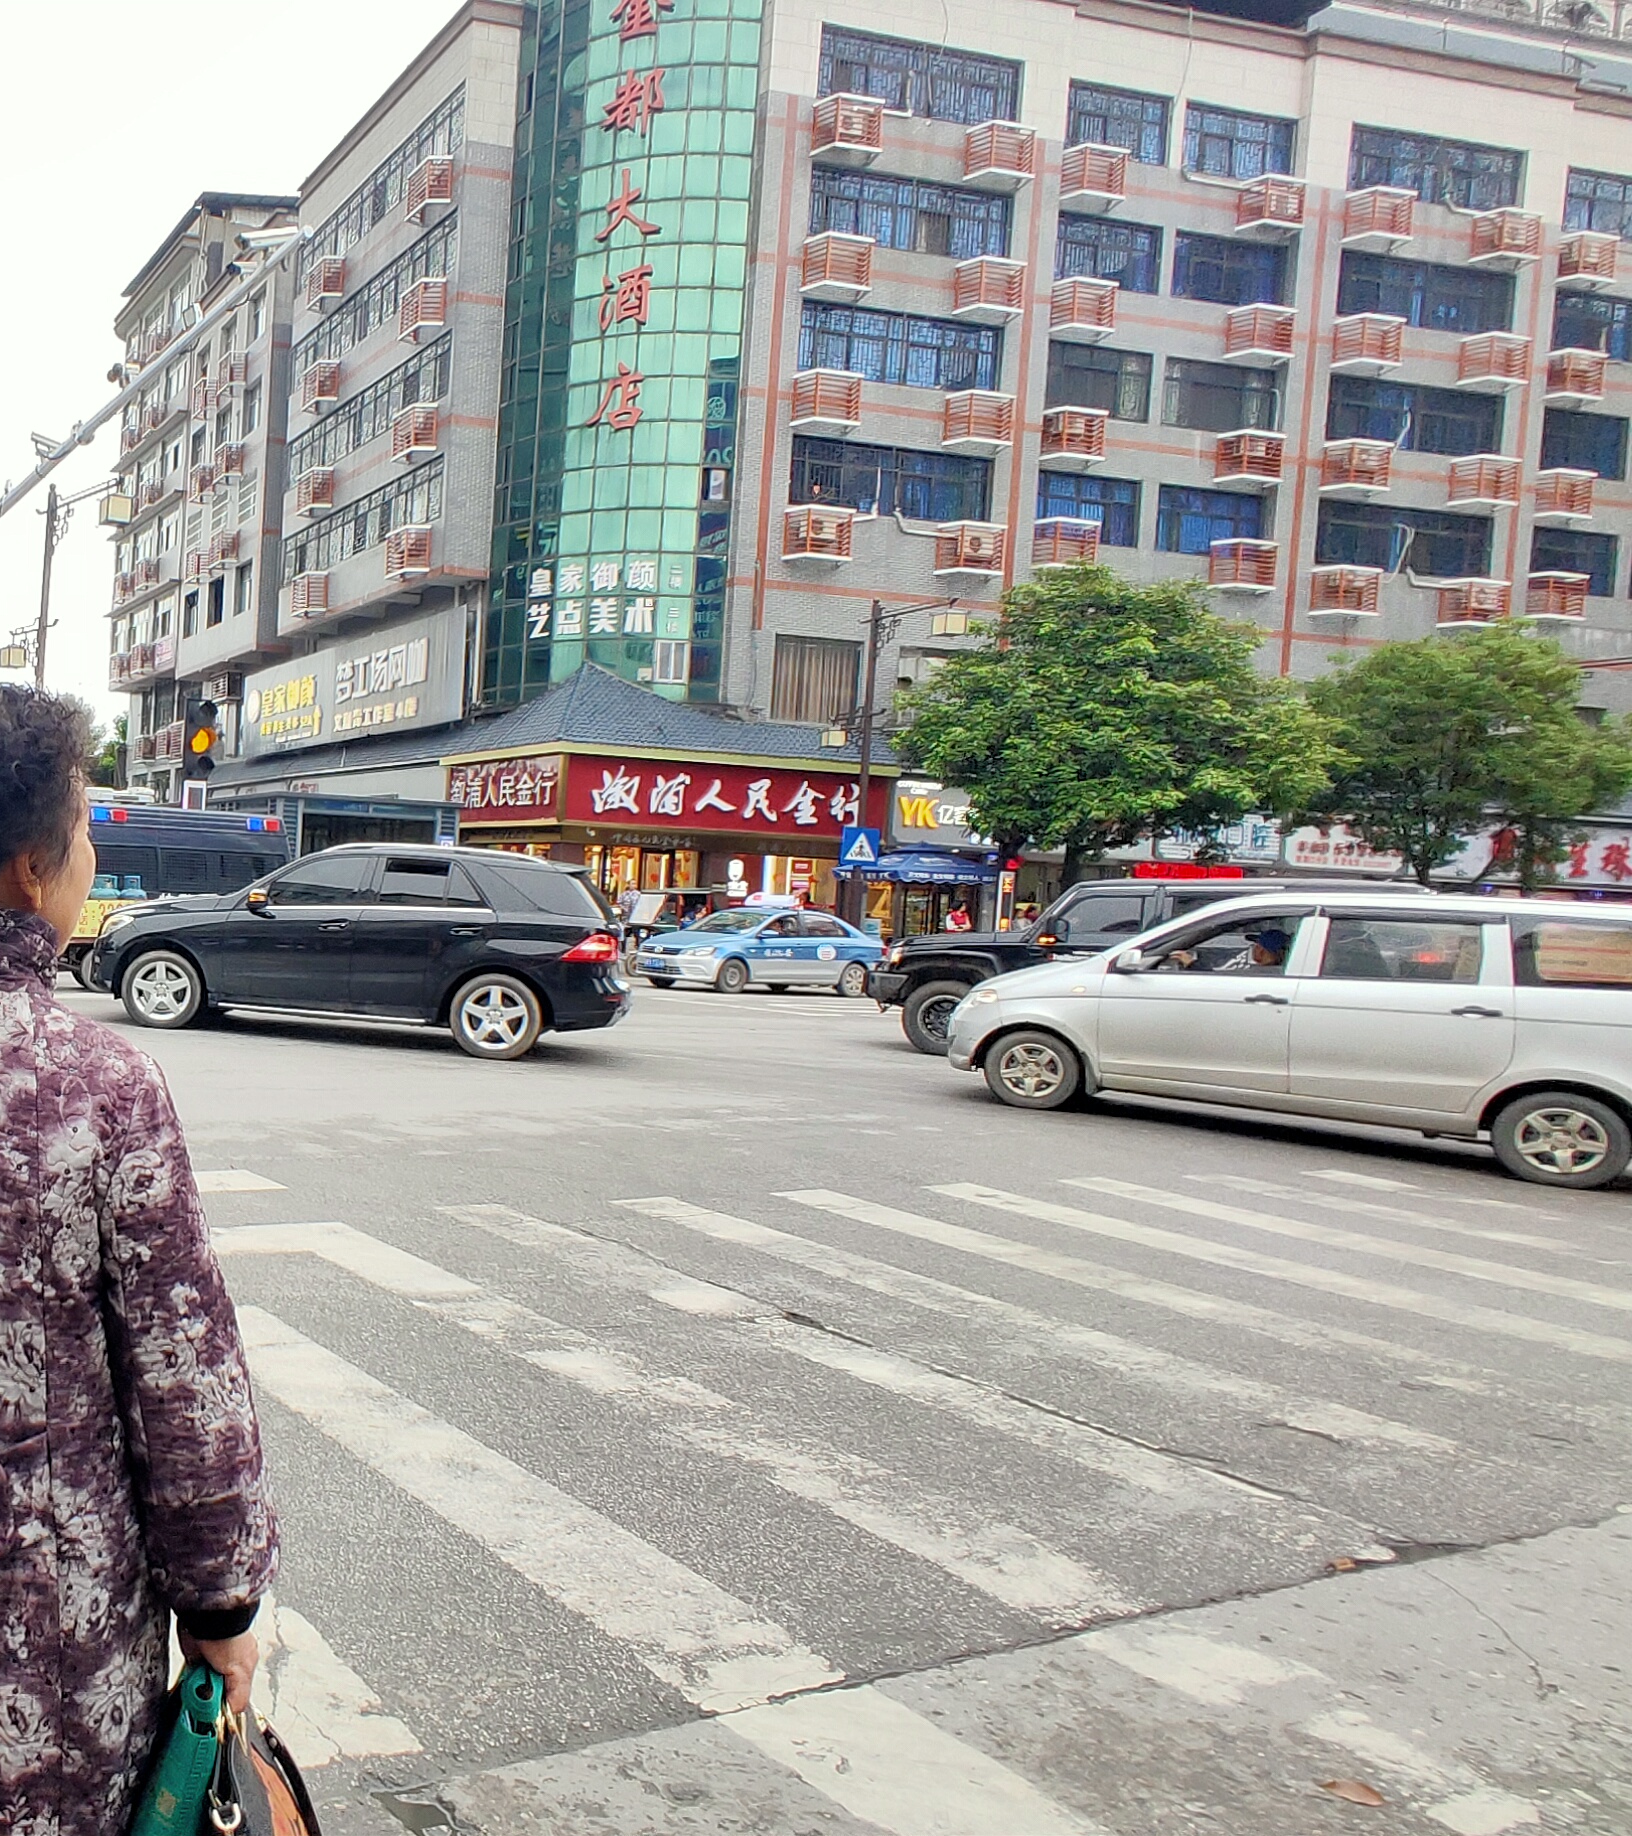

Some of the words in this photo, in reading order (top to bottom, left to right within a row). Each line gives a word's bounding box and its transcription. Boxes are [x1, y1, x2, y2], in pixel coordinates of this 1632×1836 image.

[528, 559, 657, 598] 皇家御颜
[527, 597, 655, 640] 艺点美术
[335, 637, 430, 704] 梦工场网咖
[261, 674, 317, 719] 皇家御颜
[591, 765, 860, 828] 溆浦人民金行
[898, 795, 940, 829] YK
